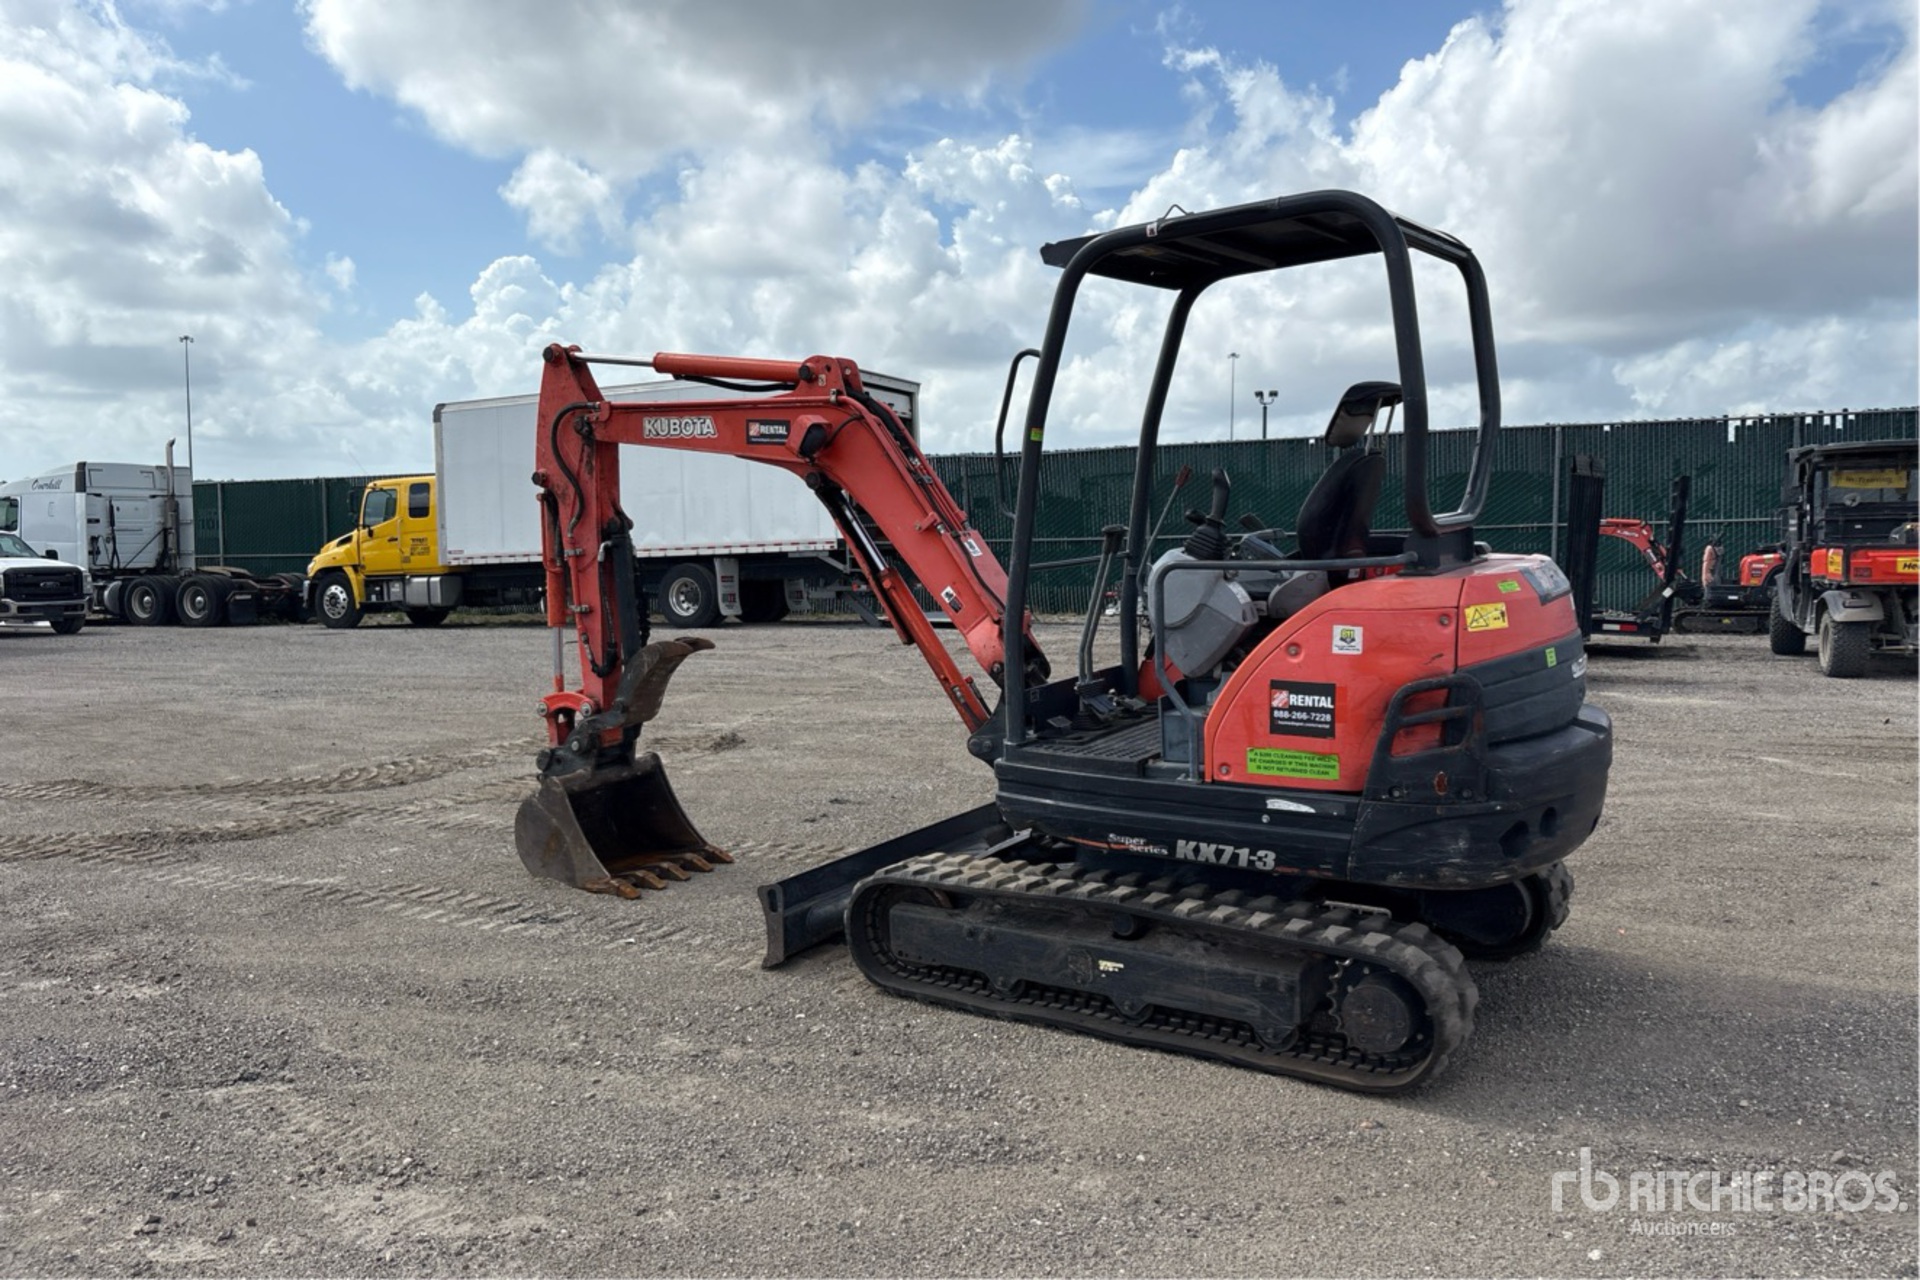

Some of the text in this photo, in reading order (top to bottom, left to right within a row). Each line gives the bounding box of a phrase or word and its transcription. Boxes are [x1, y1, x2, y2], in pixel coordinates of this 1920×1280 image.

[643, 416, 718, 438] KUBOTA
[759, 425, 788, 435] RENTAL
[1289, 693, 1334, 709] RENTAL
[1273, 709, 1331, 722] 888-266-7228
[1107, 833, 1146, 845] Super
[1128, 844, 1168, 855] Series
[1175, 839, 1277, 871] KX71-3
